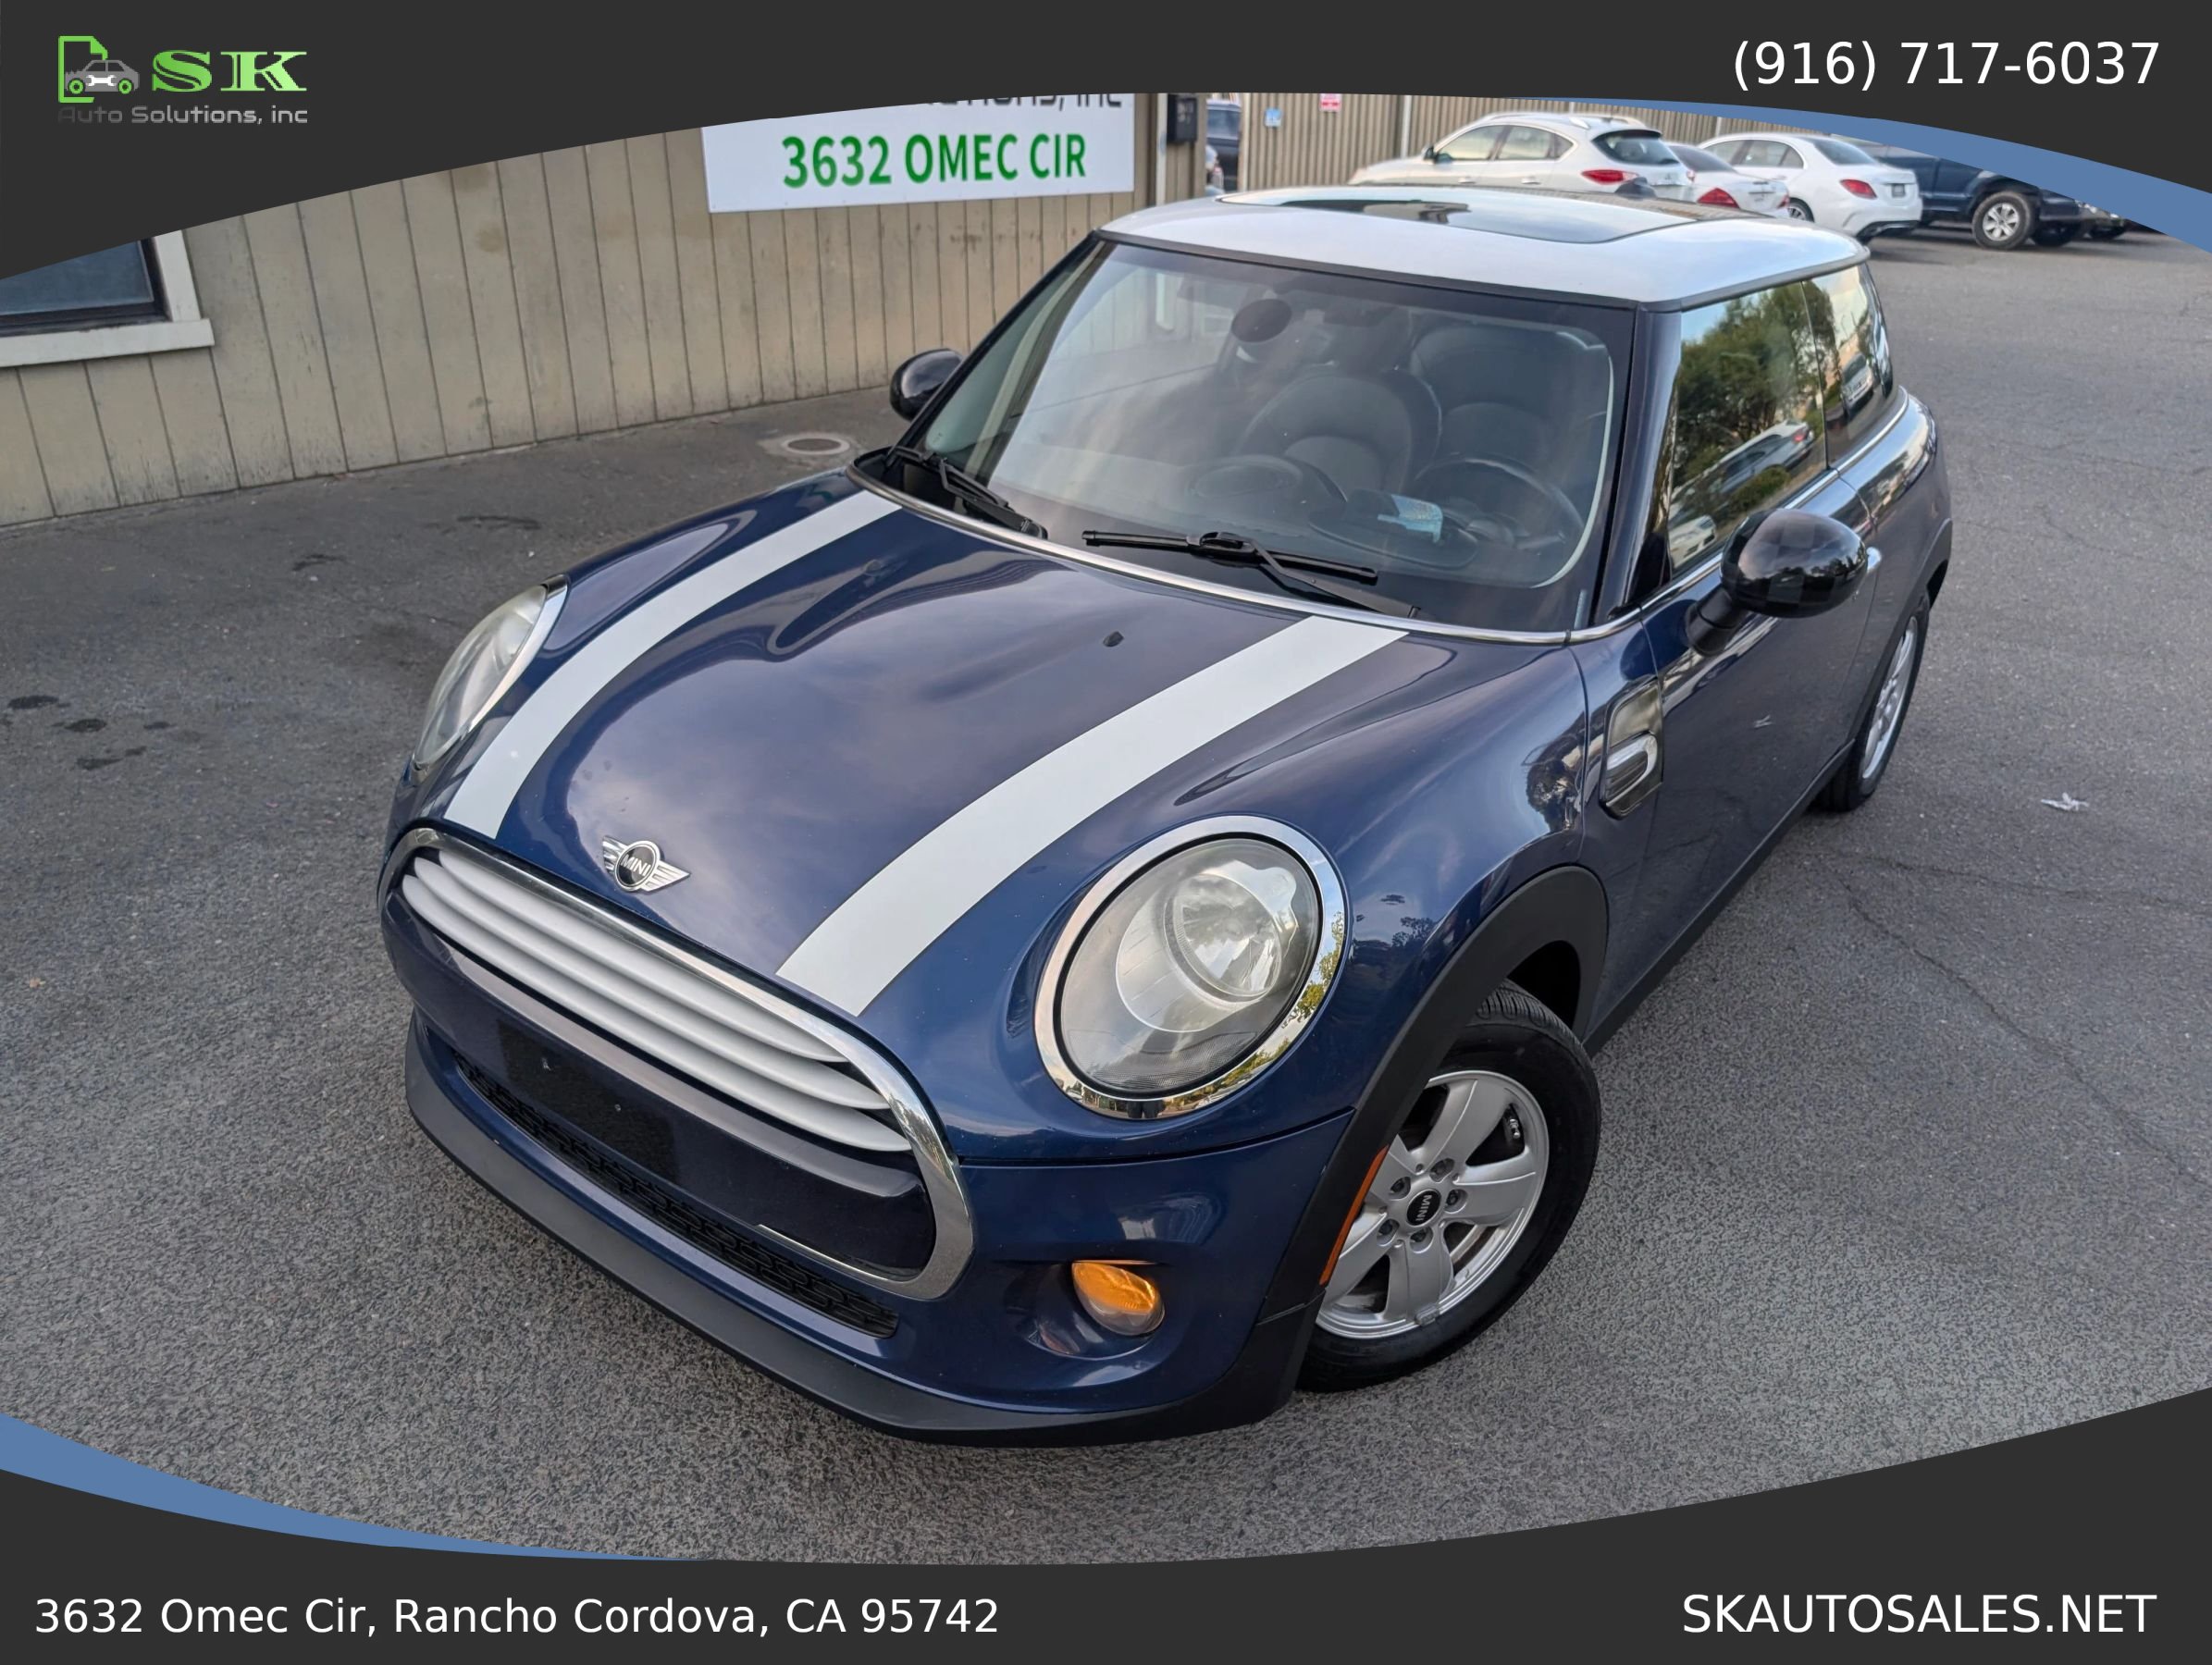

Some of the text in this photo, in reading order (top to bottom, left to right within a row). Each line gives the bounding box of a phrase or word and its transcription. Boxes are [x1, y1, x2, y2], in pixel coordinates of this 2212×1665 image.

[782, 133, 1087, 188] 3632 OMEC CIR
[620, 854, 651, 877] MINI
[1415, 1194, 1433, 1221] MINI
